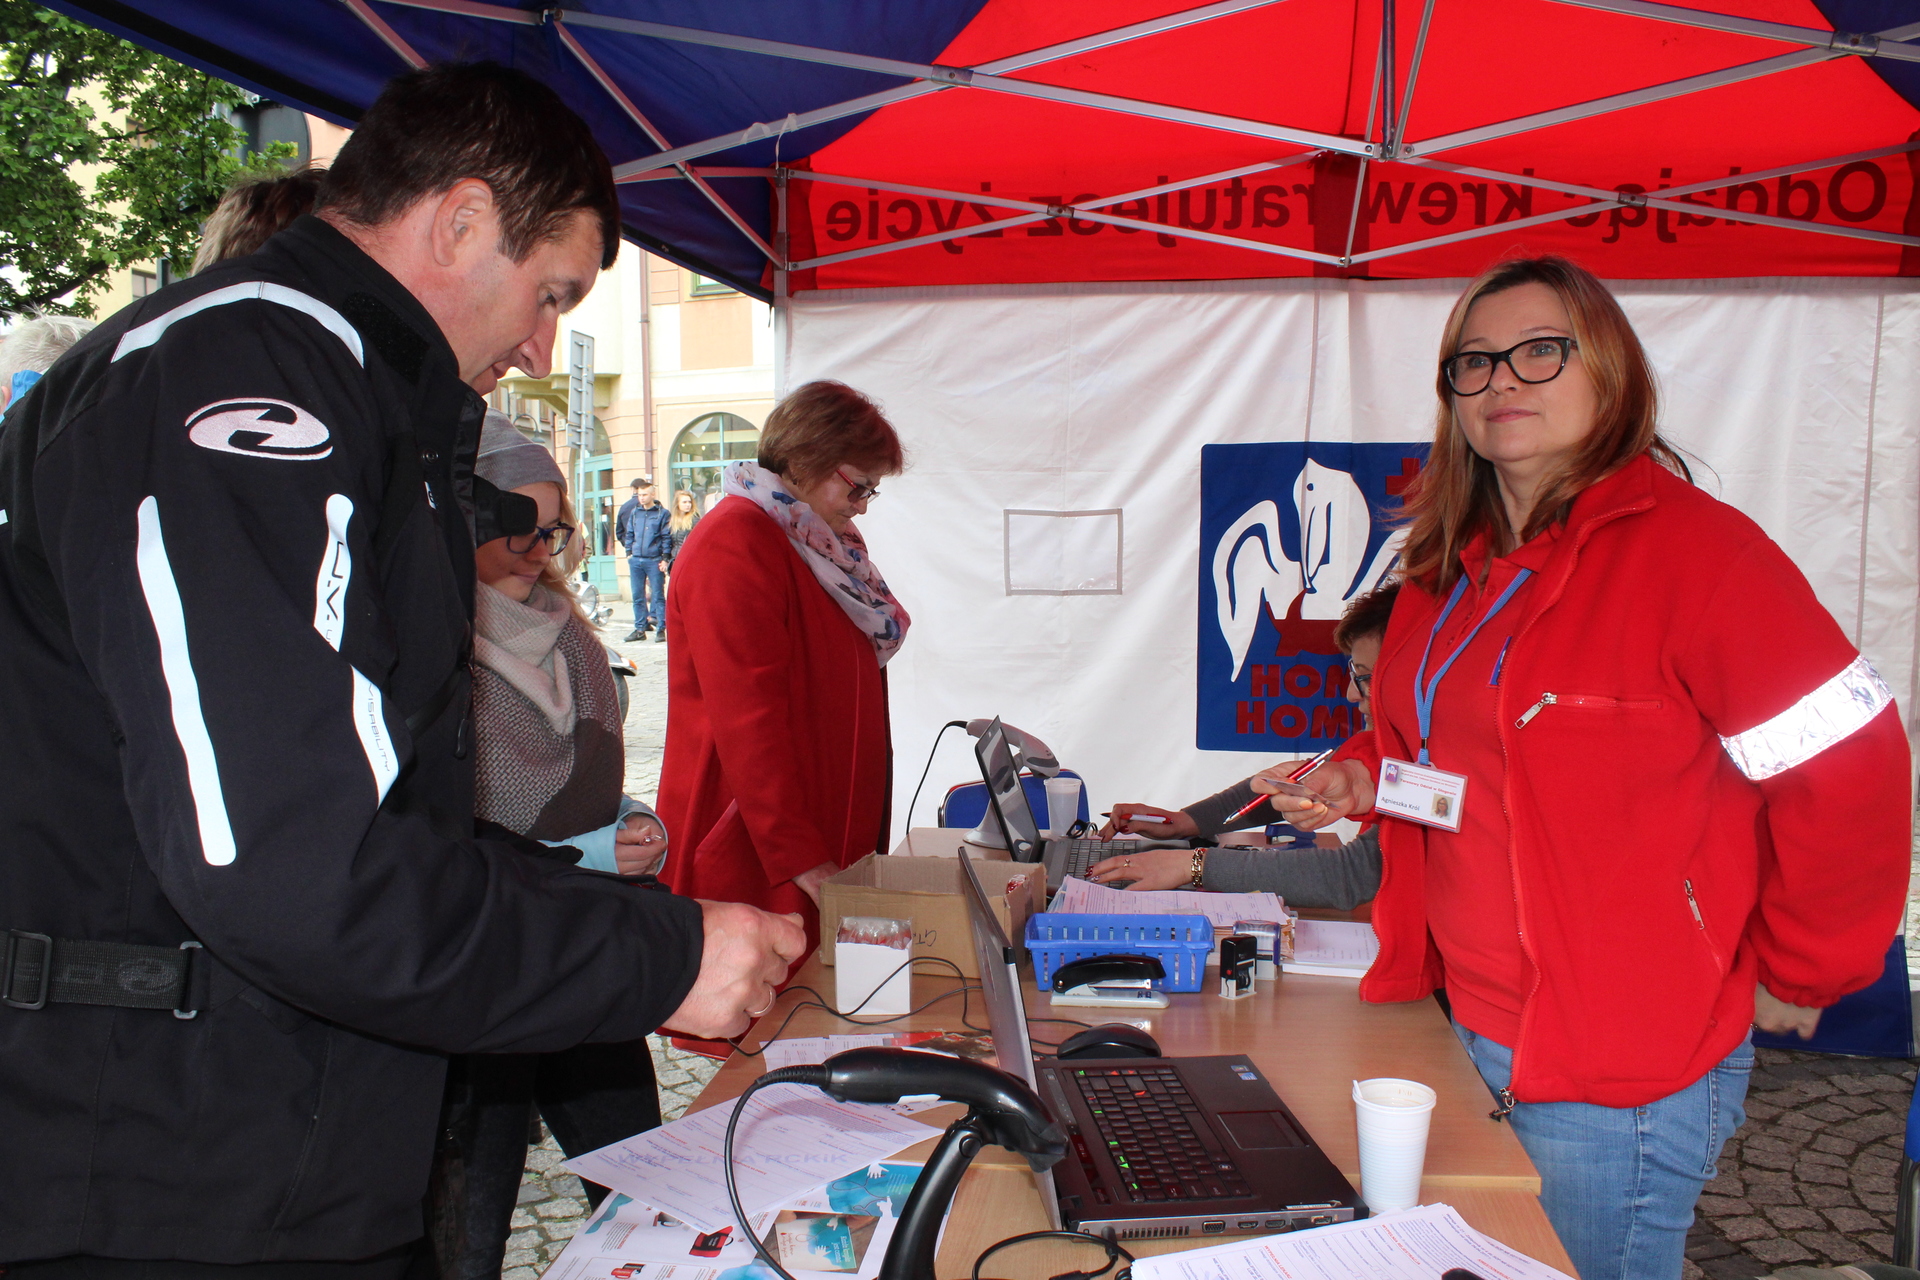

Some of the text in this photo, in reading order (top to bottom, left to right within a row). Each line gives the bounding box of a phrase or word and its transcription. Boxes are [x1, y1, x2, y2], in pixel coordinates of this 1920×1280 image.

[1251, 664, 1351, 699] HOM
[367, 683, 391, 772] VISABILITY
[1236, 701, 1363, 739] HOMI
[1381, 796, 1420, 812] Agnieszka Król
[764, 1153, 849, 1164] RCKiK
